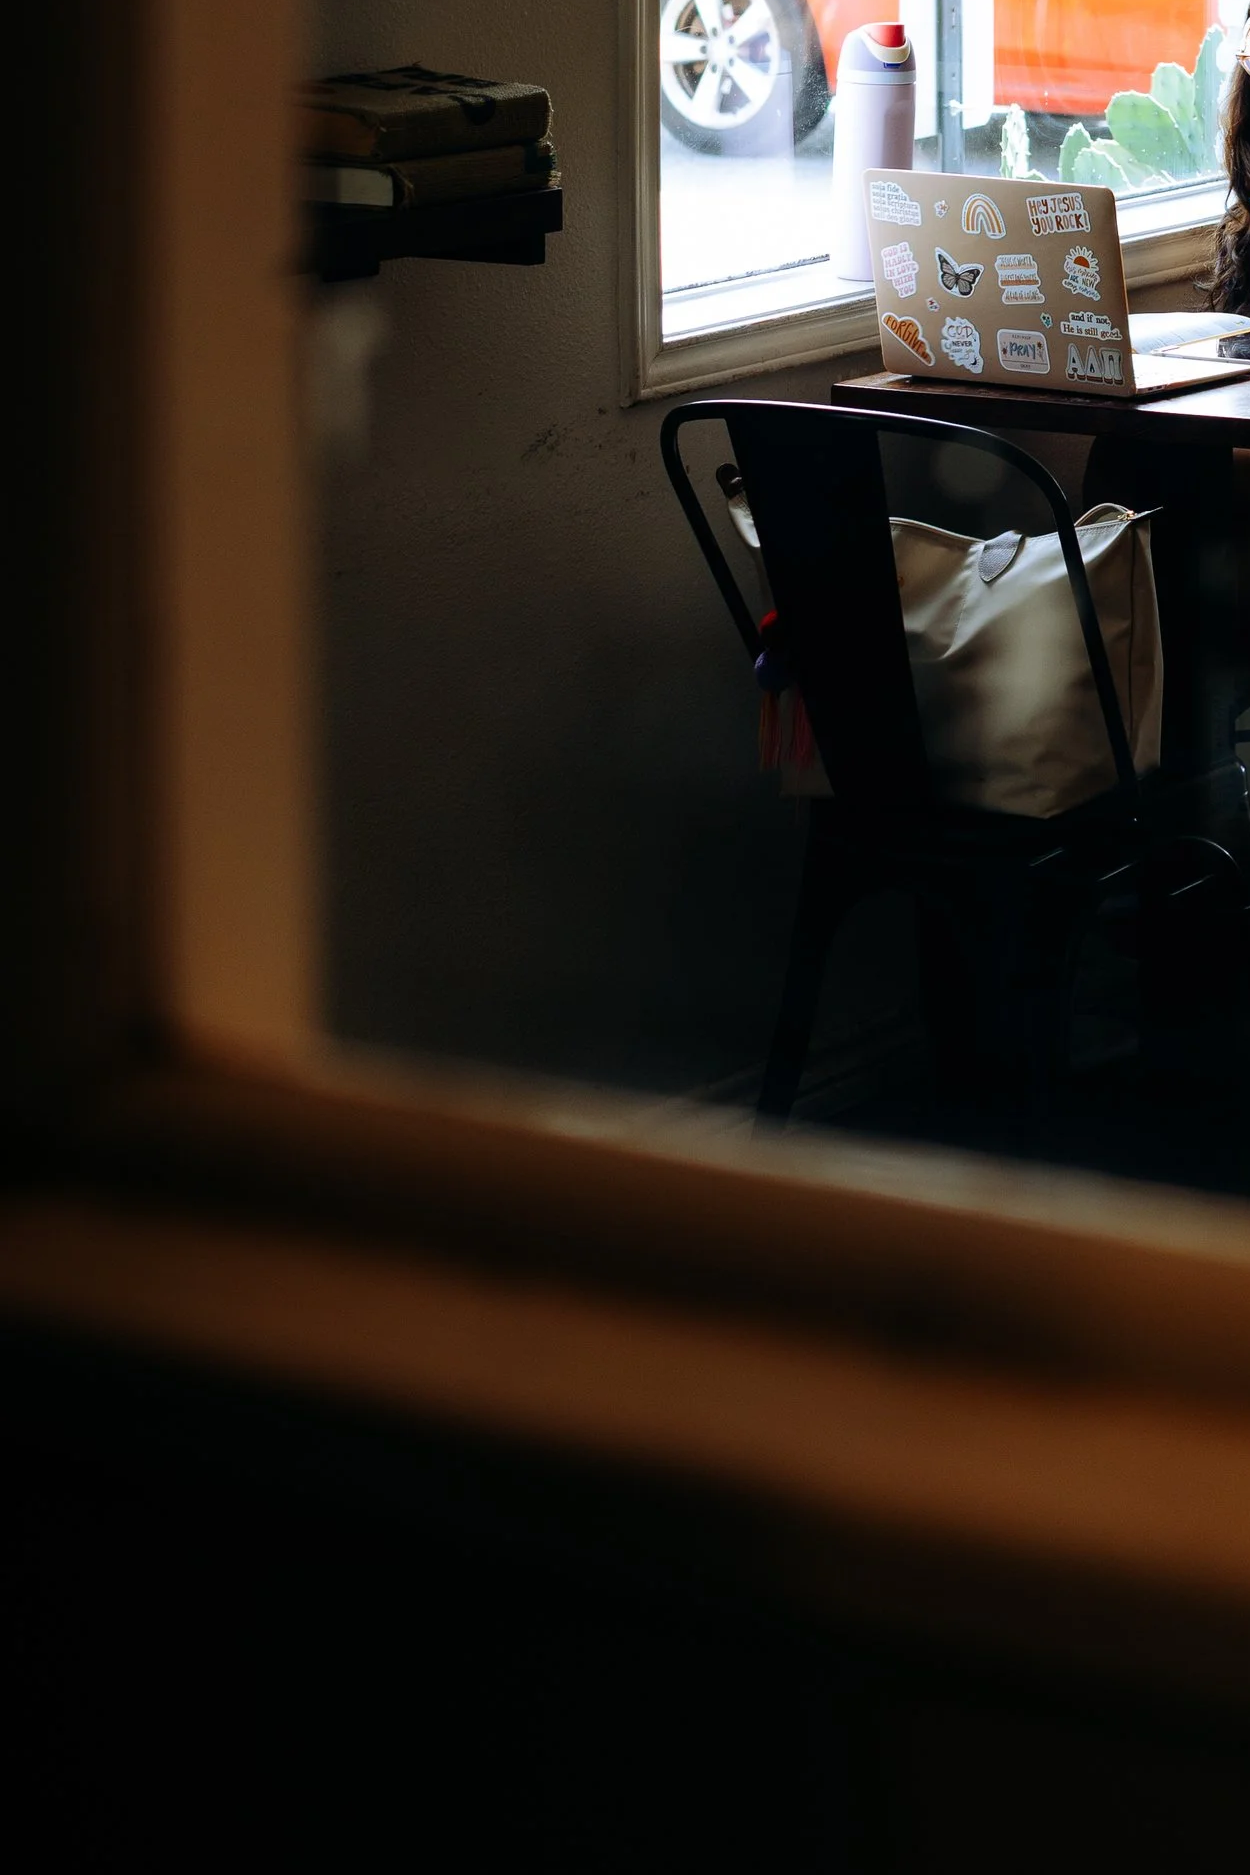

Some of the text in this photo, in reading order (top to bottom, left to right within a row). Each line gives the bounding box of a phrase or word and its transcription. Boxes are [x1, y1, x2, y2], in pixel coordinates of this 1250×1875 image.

[887, 183, 900, 192] fide
[887, 192, 907, 201] gratia
[1055, 212, 1089, 231] ROCK!
[883, 243, 908, 258] GOD IS
[885, 253, 912, 268] MADLY
[886, 263, 917, 277] IN LOVE
[899, 284, 914, 296] YOU
[1071, 313, 1110, 326] and if not,
[1062, 323, 1121, 339] He is still good.
[1009, 341, 1036, 360] PRAY
